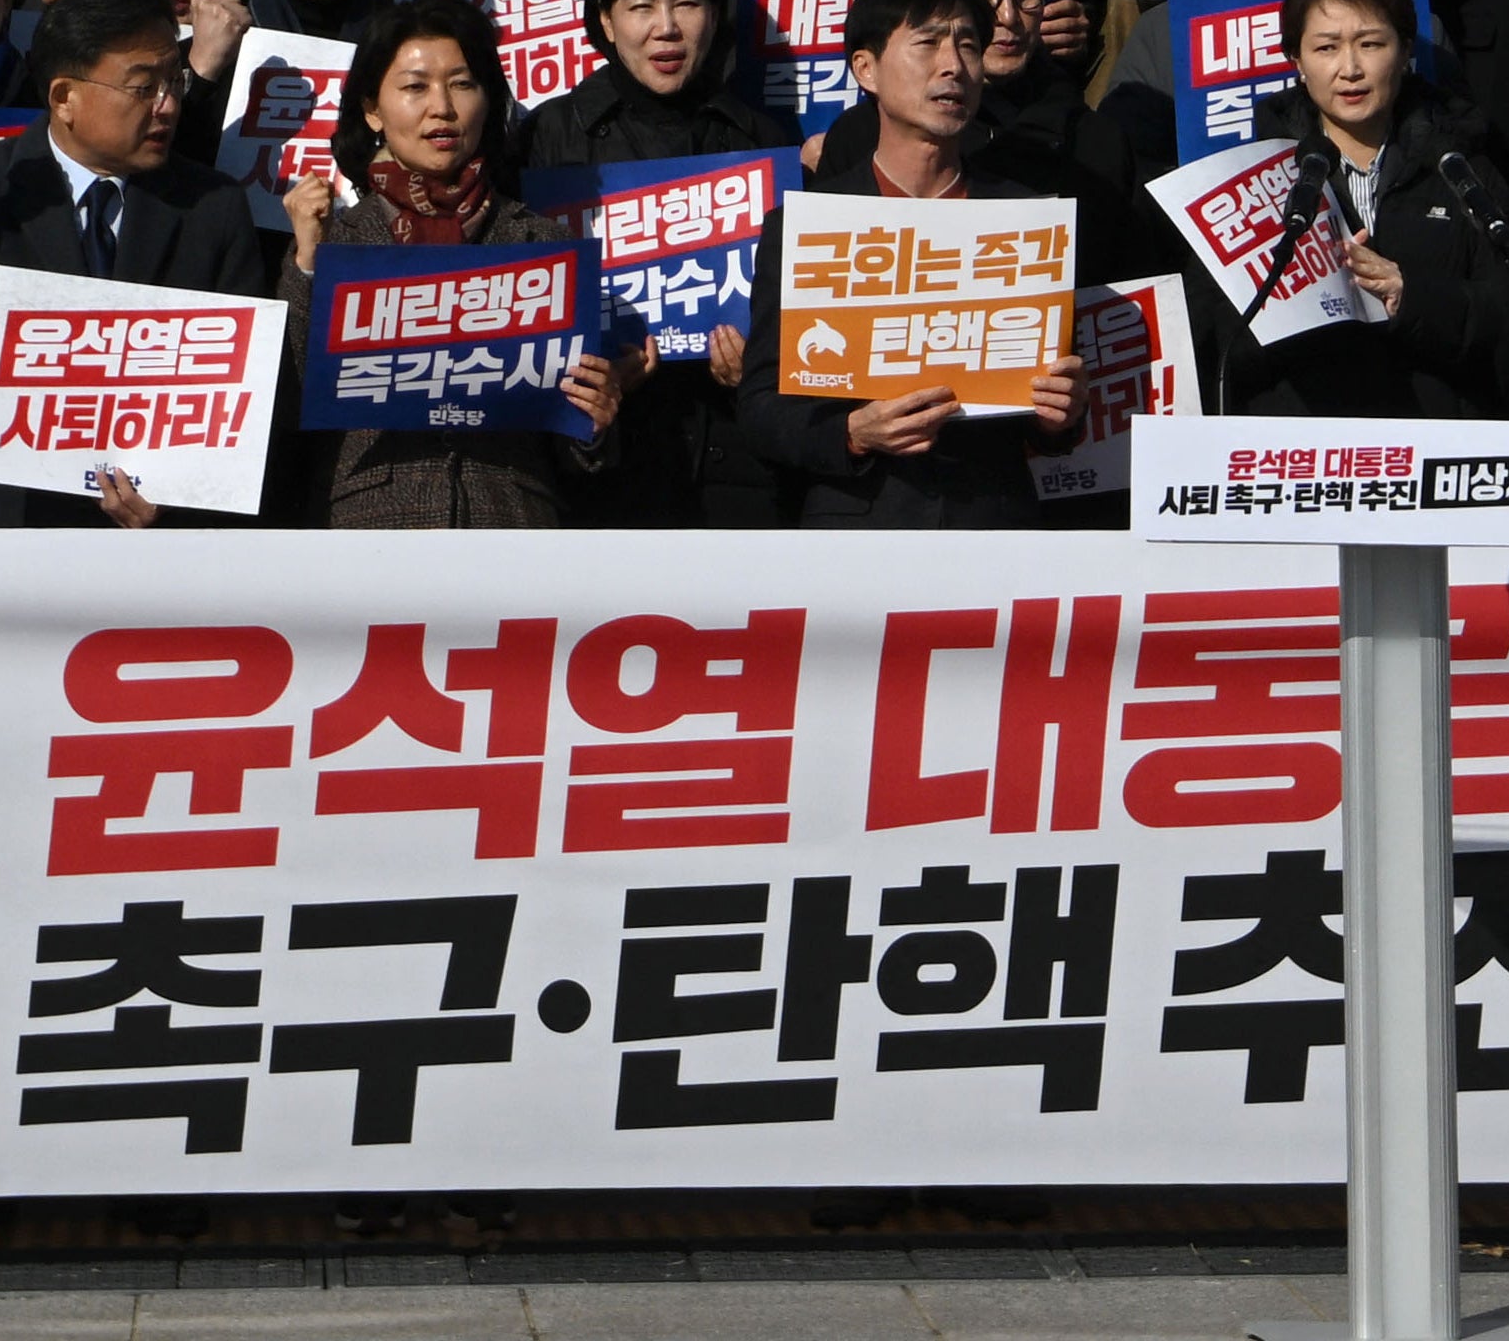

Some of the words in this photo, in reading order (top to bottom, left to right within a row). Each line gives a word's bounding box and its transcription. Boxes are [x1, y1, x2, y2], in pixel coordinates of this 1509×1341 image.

[794, 225, 961, 299] 국회는
[973, 223, 1070, 285] 즉각
[341, 262, 567, 342] 내란행위
[12, 316, 238, 378] 윤석열은
[868, 305, 1062, 377] 탄핵을!
[1159, 484, 1217, 515] 사퇴
[1225, 482, 1354, 513] 촉구·탄핵
[1358, 480, 1417, 511] 추진
[1227, 448, 1317, 480] 윤석열
[1323, 446, 1414, 478] 대통령
[47, 607, 806, 876] 윤석열
[19, 863, 1121, 1155] 촉구·탄핵
